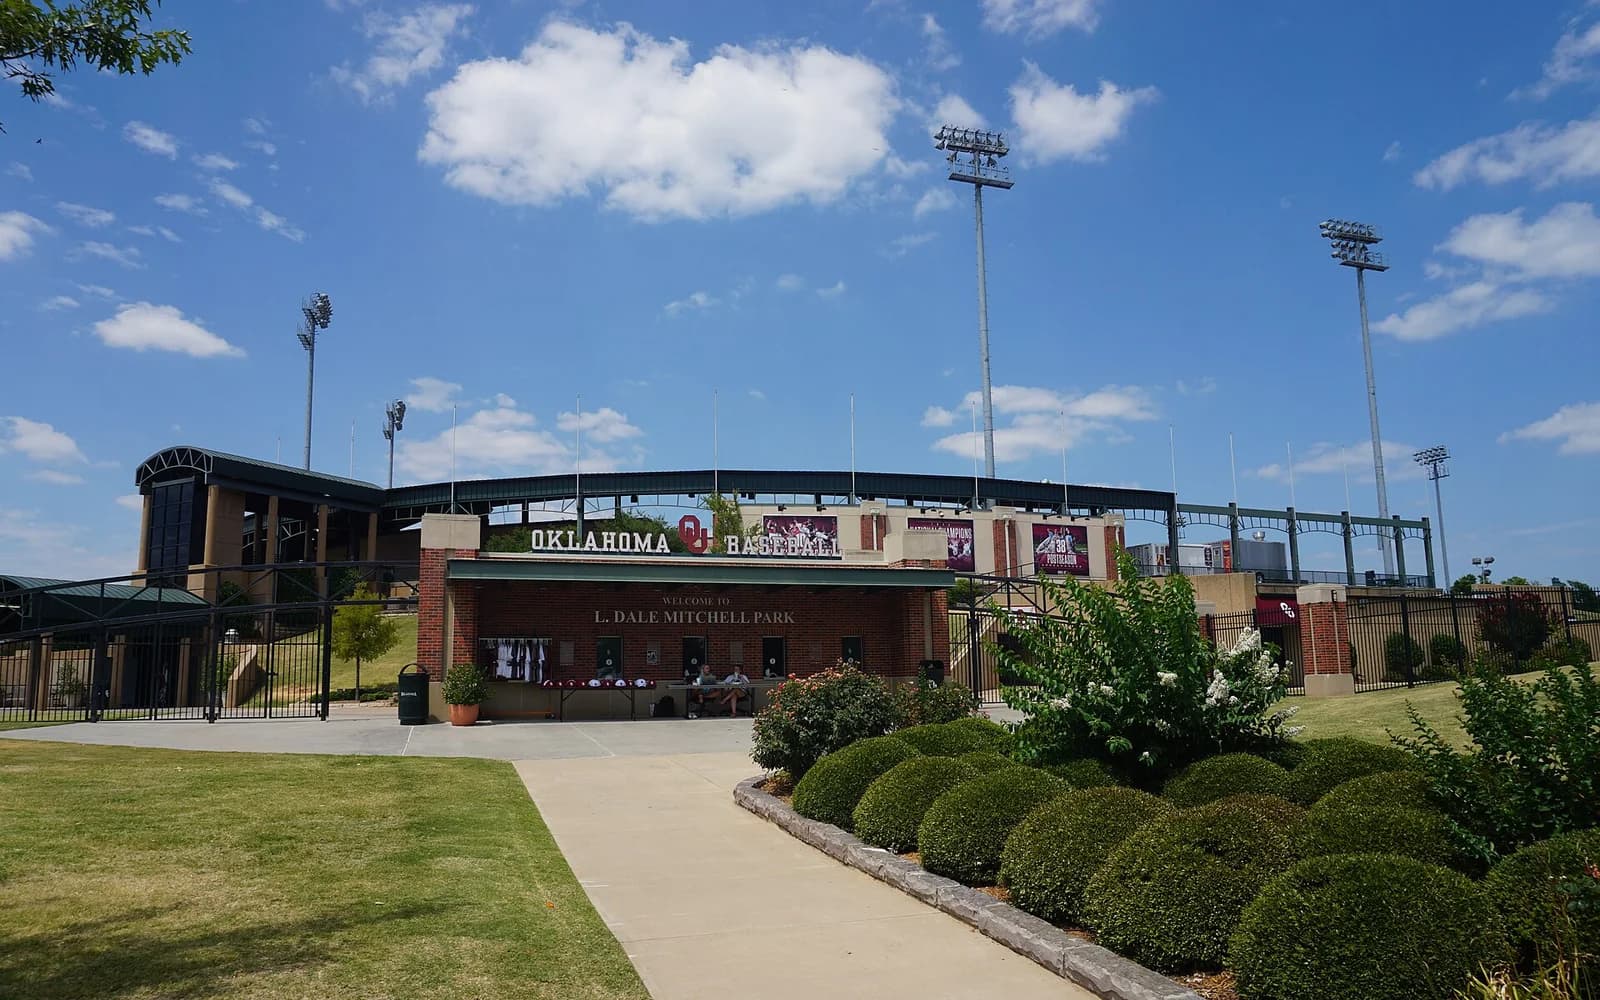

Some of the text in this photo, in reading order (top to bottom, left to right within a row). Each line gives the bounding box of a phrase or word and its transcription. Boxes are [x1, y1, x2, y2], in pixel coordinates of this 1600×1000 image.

[531, 514, 842, 557] OKLAHOMA OU BASEBALL
[940, 527, 973, 539] AMPIONS
[1056, 540, 1067, 553] 38
[663, 597, 730, 606] WELCOME TO
[595, 610, 795, 624] L. DALE MITCHELL PARK
